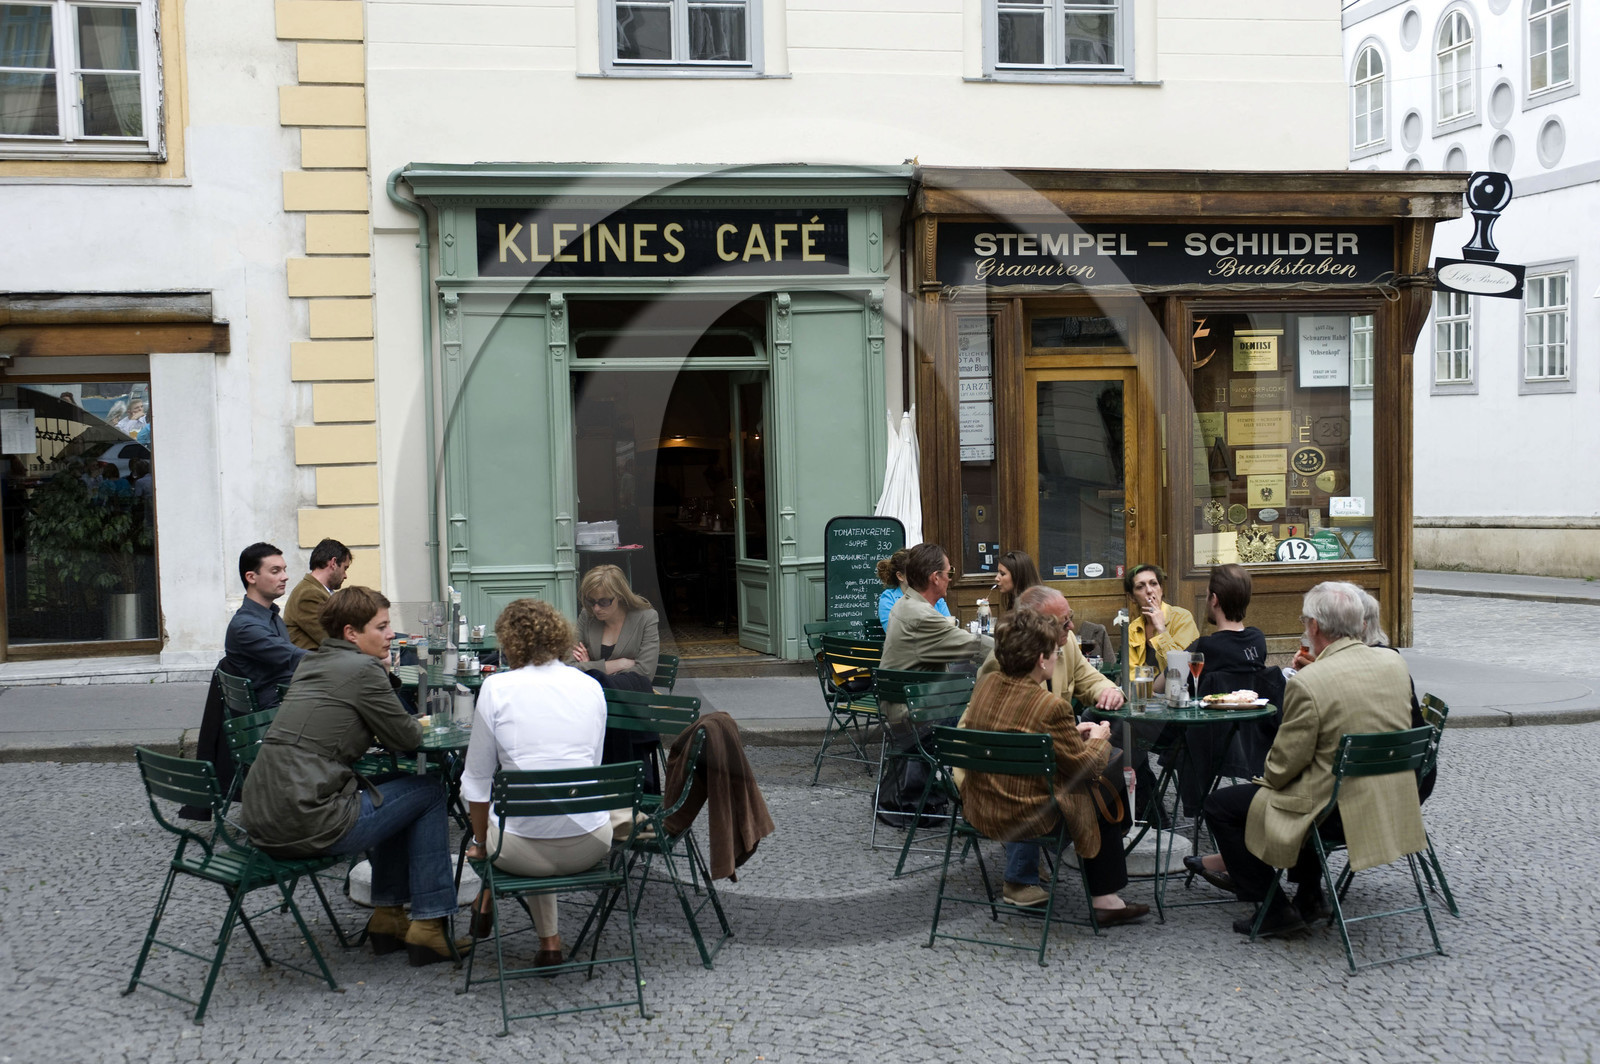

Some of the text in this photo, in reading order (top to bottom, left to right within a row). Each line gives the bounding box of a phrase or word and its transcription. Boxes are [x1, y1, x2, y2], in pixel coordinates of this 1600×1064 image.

[498, 215, 826, 263] KLEINES CAFÉ
[973, 232, 1137, 256] STEMPEL
[1184, 232, 1359, 256] SCHILDER
[974, 257, 1096, 281] Gravuren
[1208, 257, 1358, 279] Buchstaben
[1240, 342, 1272, 351] DENTIST
[1298, 452, 1318, 465] 25
[1286, 542, 1310, 560] 12
